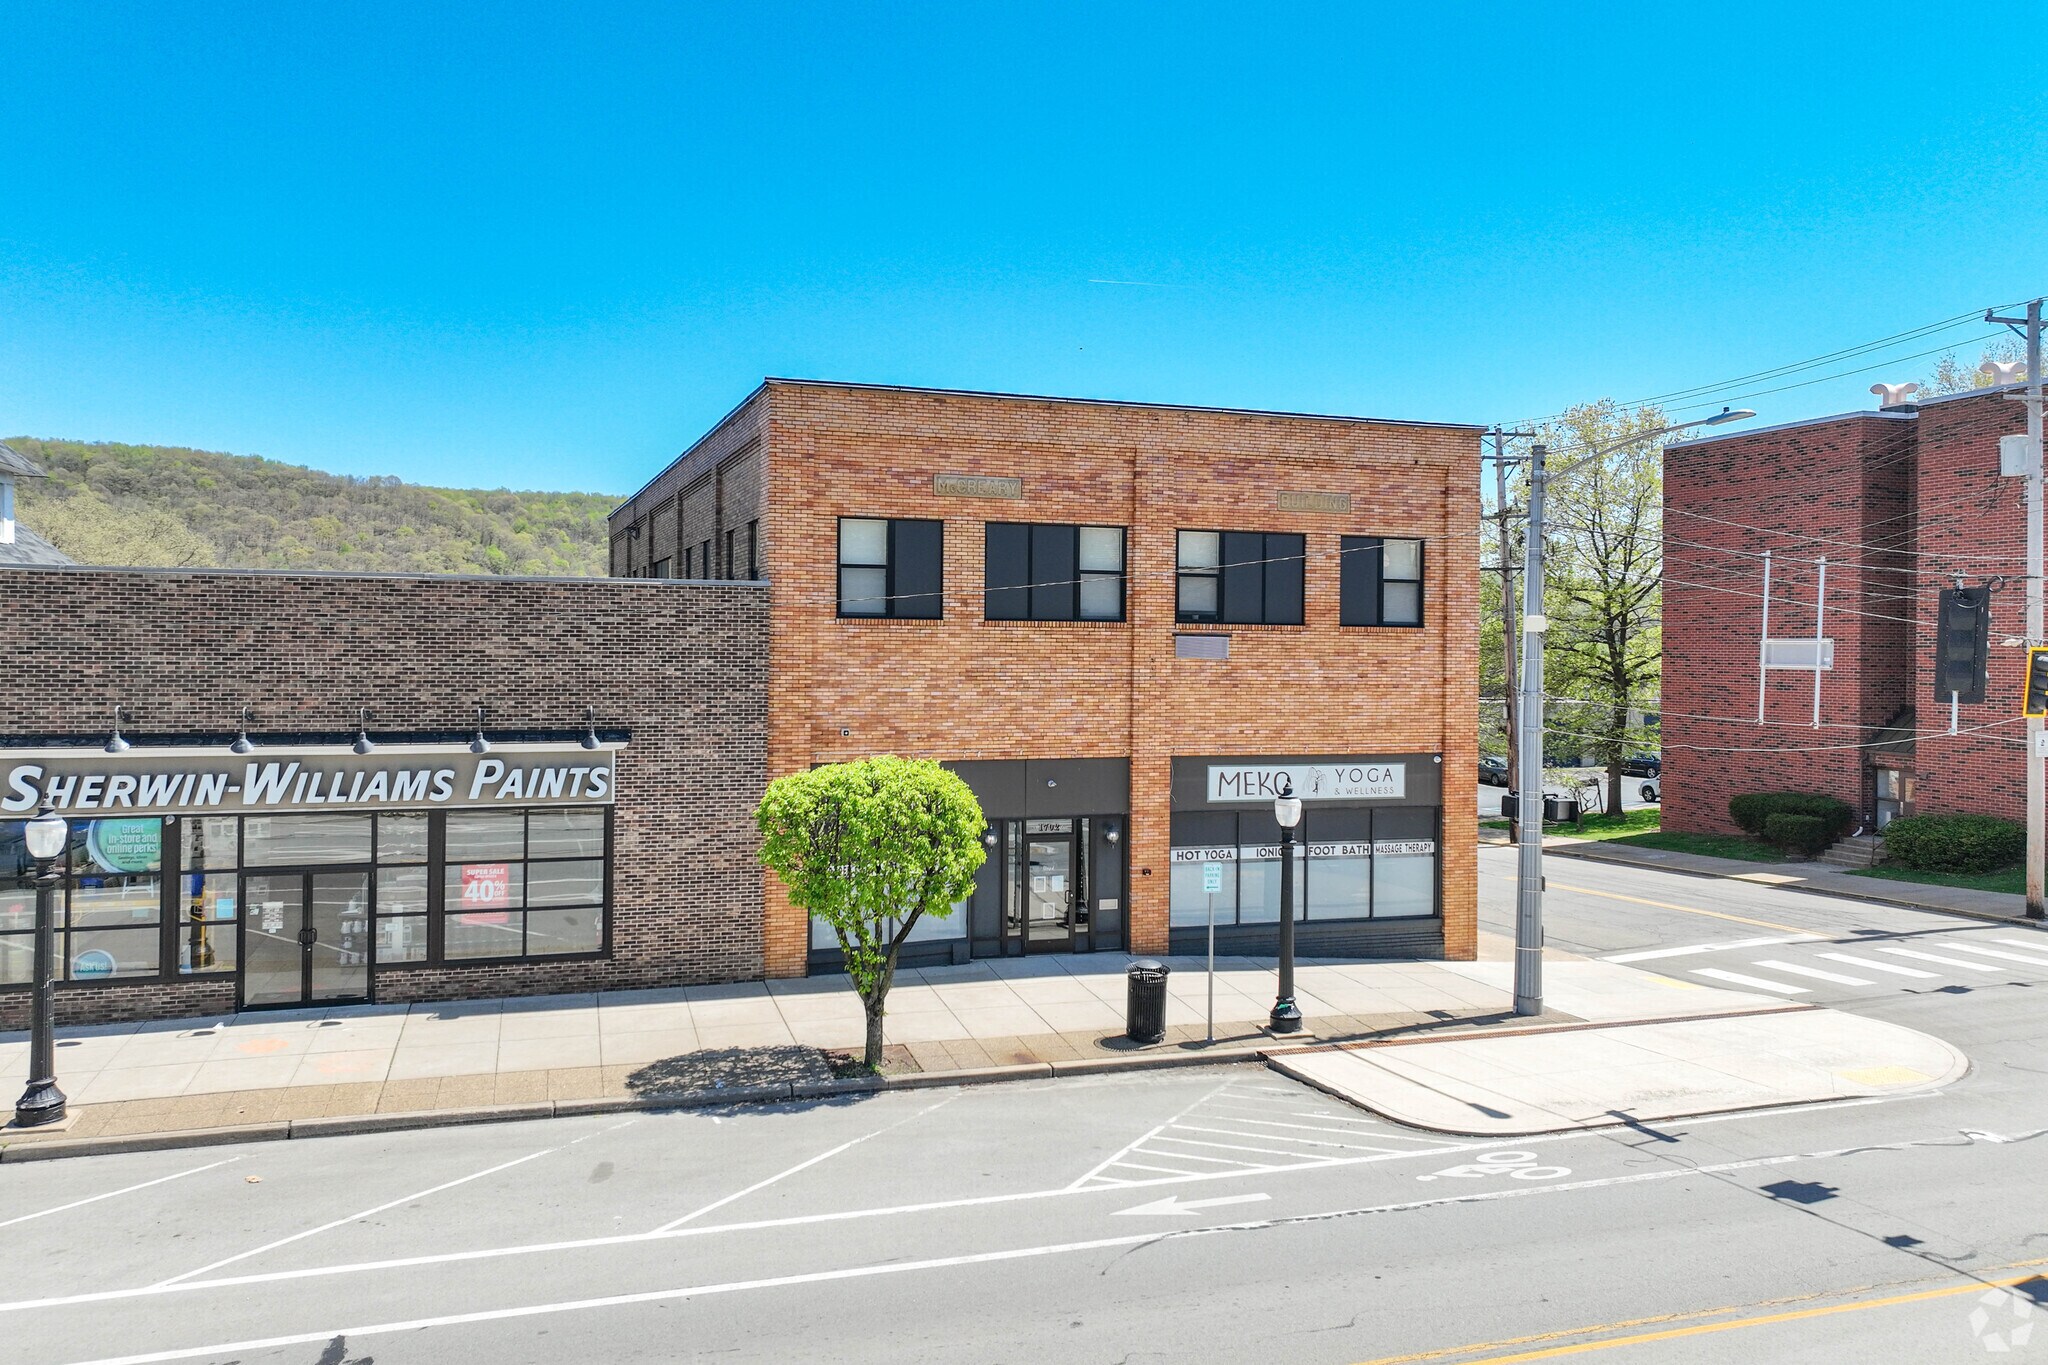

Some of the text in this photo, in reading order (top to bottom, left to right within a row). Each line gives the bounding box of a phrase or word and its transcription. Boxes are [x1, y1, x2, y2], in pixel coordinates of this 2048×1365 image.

[1335, 768, 1393, 783] YOGA
[1, 758, 611, 812] SHERWIN-WILLIAMS PAINTS
[1218, 771, 1292, 797] MEKO
[1334, 786, 1394, 796] & WELLNESS
[122, 824, 144, 834] Great
[141, 833, 158, 843] and
[107, 844, 133, 855] online
[1308, 845, 1370, 856] FOOT BATH
[1375, 843, 1432, 854] MASSAGE THERAPY
[1176, 849, 1233, 861] HOT YOGA
